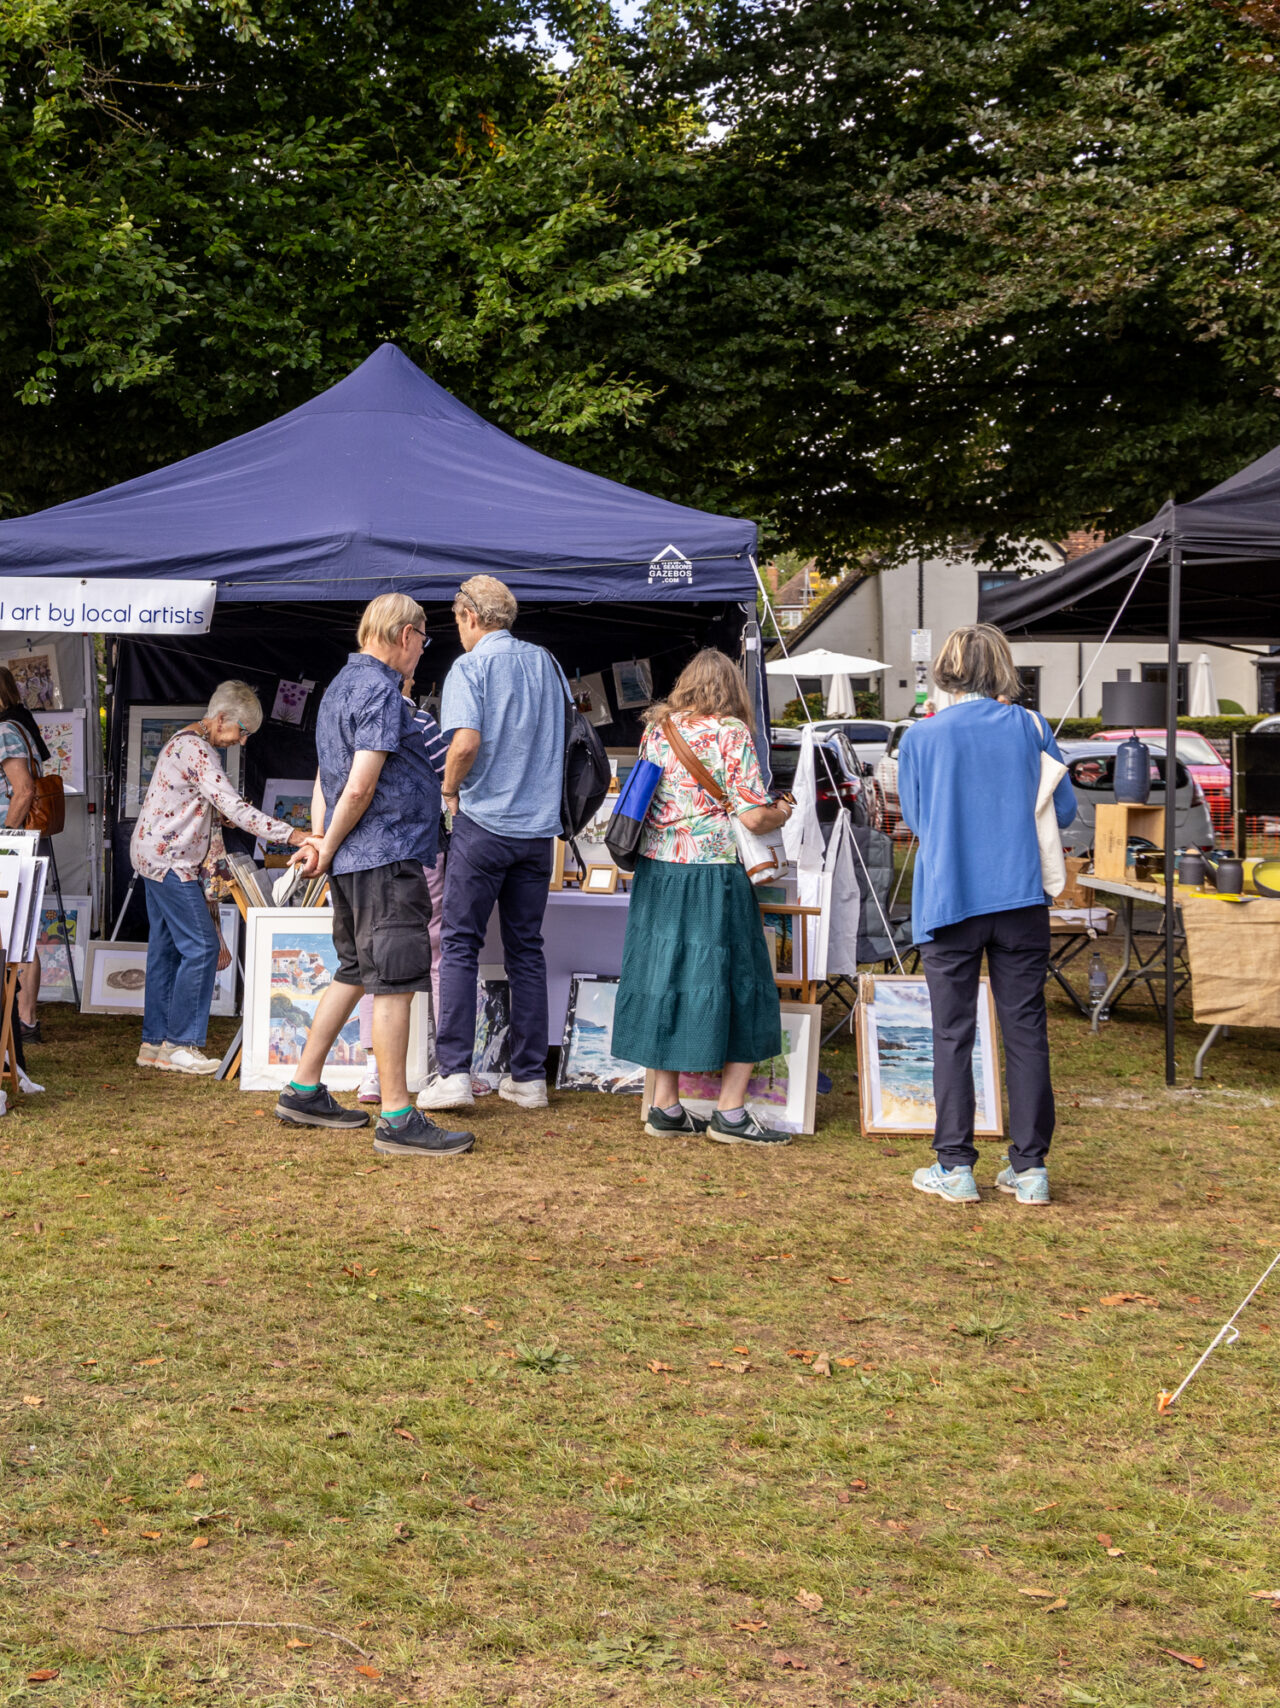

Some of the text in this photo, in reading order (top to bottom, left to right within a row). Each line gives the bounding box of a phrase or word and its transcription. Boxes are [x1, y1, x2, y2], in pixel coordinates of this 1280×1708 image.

[11, 604, 41, 621] art
[48, 602, 75, 627] by
[81, 603, 132, 623] local
[138, 605, 207, 625] artists
